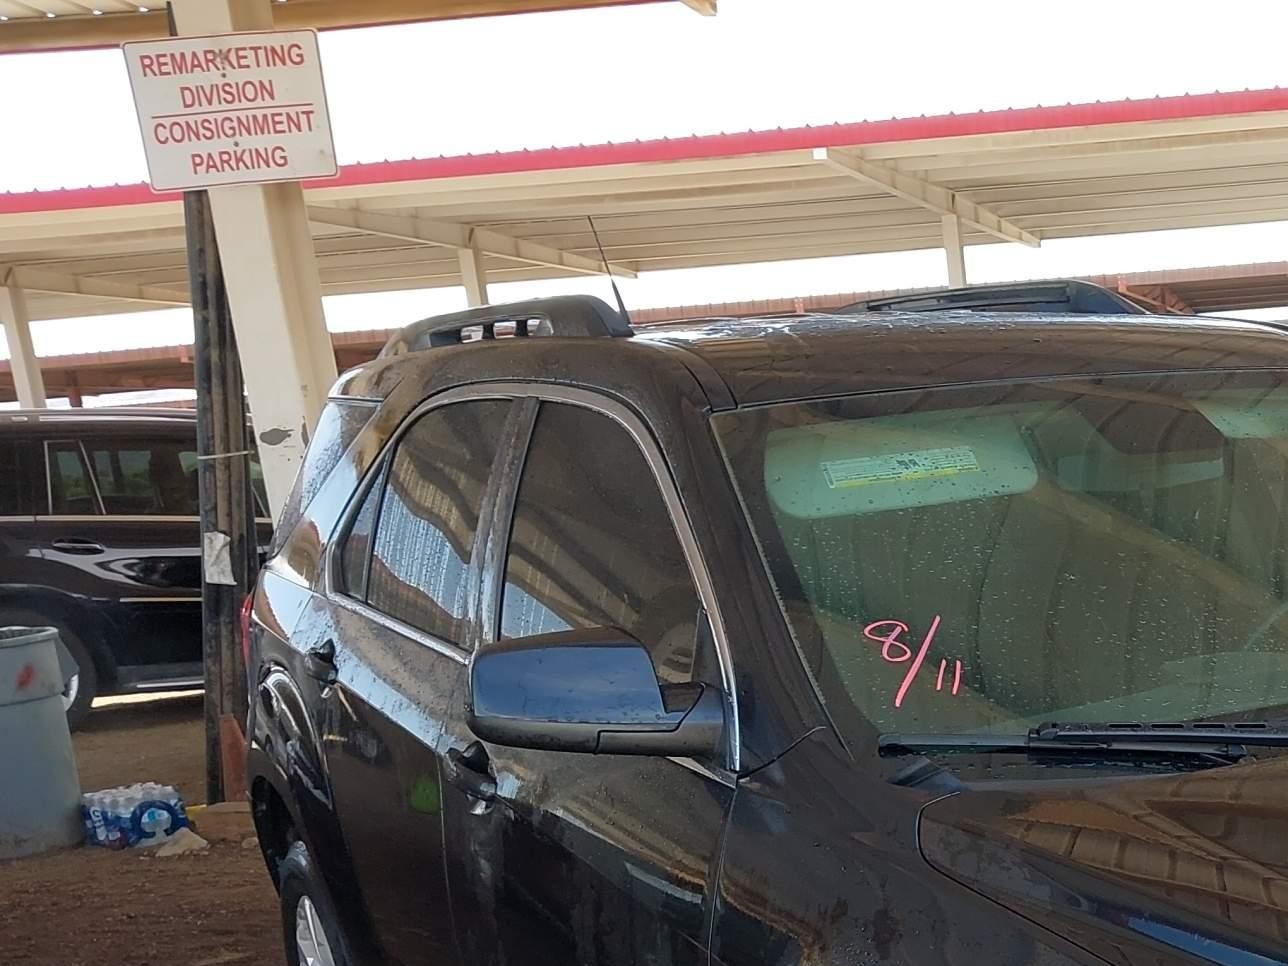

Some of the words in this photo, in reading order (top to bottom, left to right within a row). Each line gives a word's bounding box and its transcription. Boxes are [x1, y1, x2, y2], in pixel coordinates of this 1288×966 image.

[139, 43, 305, 77] REMARKETING
[179, 80, 275, 108] DIVISION
[154, 110, 314, 145] CONSIGNMENT
[191, 146, 288, 175] PARKING
[863, 614, 962, 708] 8/11
